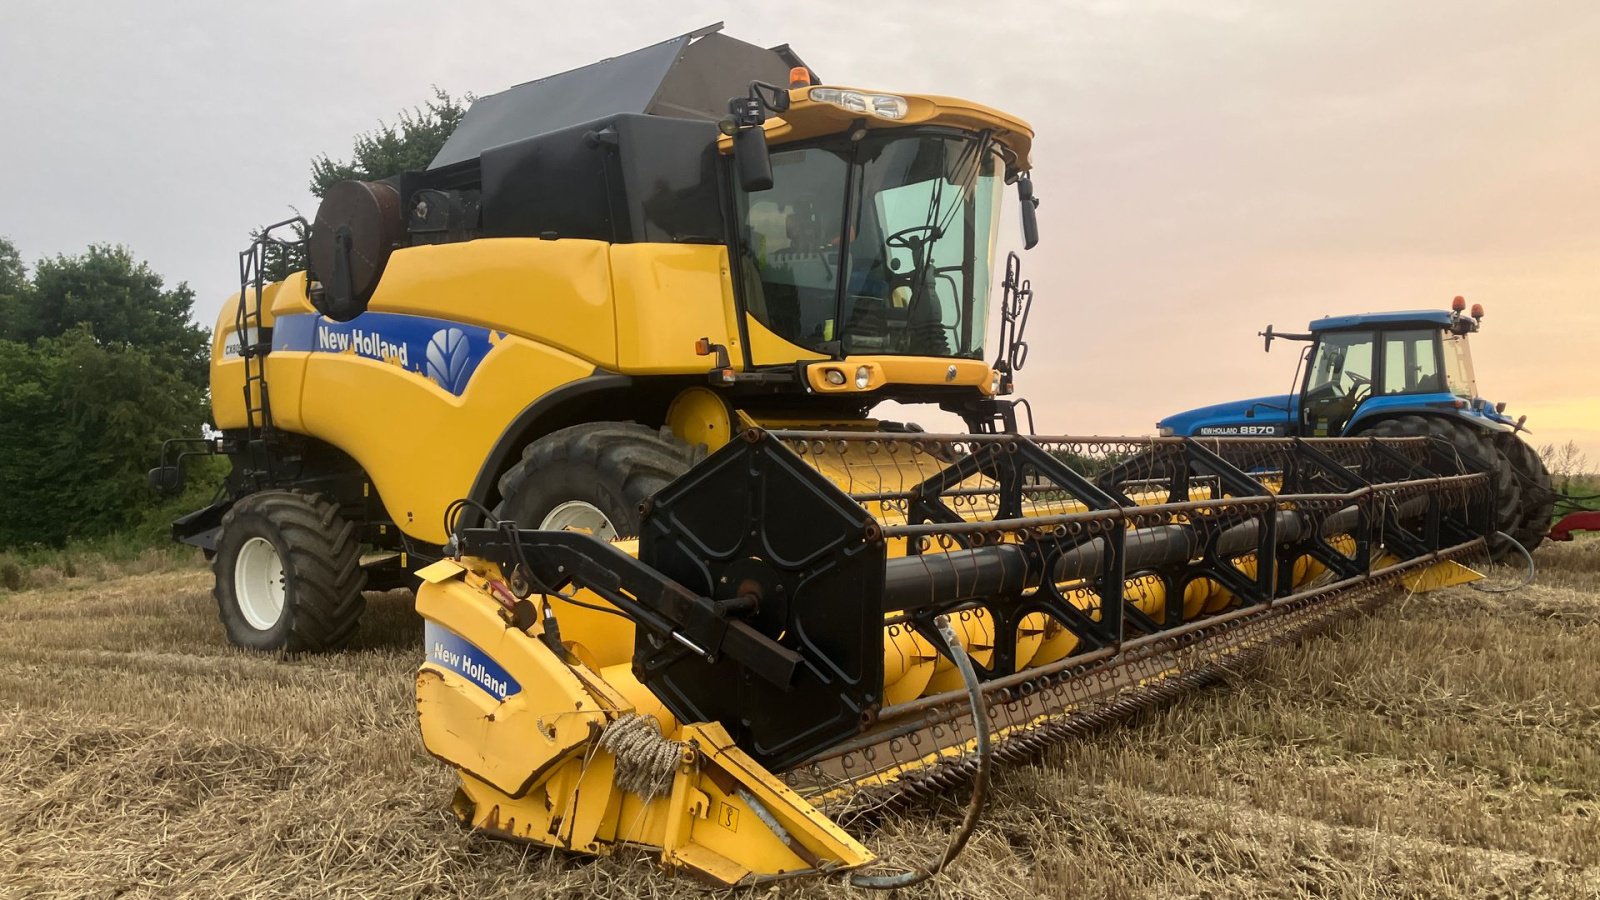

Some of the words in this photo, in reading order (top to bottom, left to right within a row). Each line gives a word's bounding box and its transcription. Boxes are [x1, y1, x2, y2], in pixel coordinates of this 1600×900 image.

[319, 326, 348, 350] New
[352, 329, 408, 366] Holland
[1240, 426, 1275, 434] 8870
[434, 642, 460, 667] New
[462, 655, 507, 697] Holland
